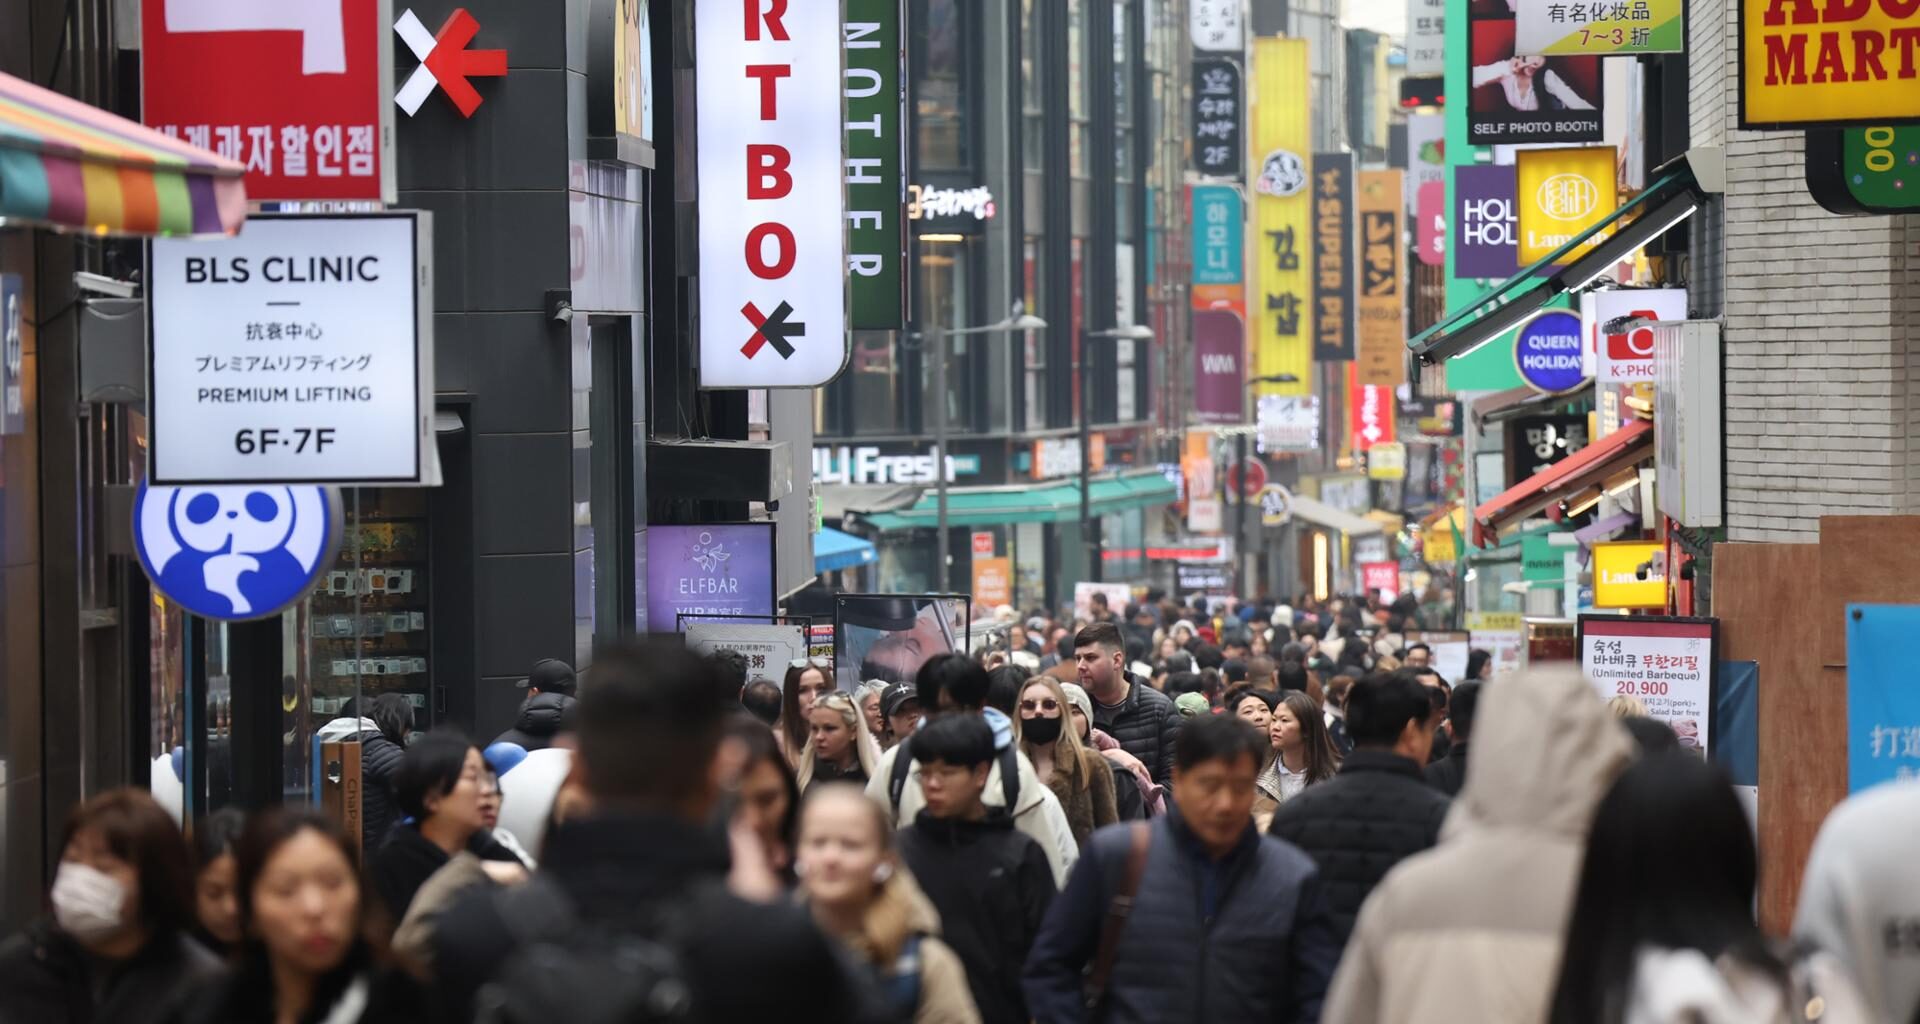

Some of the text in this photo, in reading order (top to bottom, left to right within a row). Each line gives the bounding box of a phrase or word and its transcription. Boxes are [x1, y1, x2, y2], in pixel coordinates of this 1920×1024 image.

[1548, 3, 1650, 23] 有名化妆品
[1630, 27, 1650, 46] 折
[1764, 27, 1920, 86] MART
[1474, 121, 1598, 135] SELF PHOTO BOOTH
[281, 124, 374, 176] 할인점
[1204, 146, 1230, 165] 2F
[185, 256, 379, 283] BLS CLINIC
[1318, 198, 1344, 348] SUPER PET
[1265, 223, 1302, 337] 김밥
[246, 322, 323, 341] 抗衰中心
[1528, 335, 1579, 350] QUEEN
[195, 354, 372, 373] プレミアムリフティング
[198, 386, 371, 403] PREMIUM LIFTING
[680, 577, 738, 594] ELFBAR
[1594, 639, 1622, 655] 숙성
[1593, 654, 1698, 671] 바베큐 무한리필
[1592, 668, 1701, 681] (Unlimited Barbeque)
